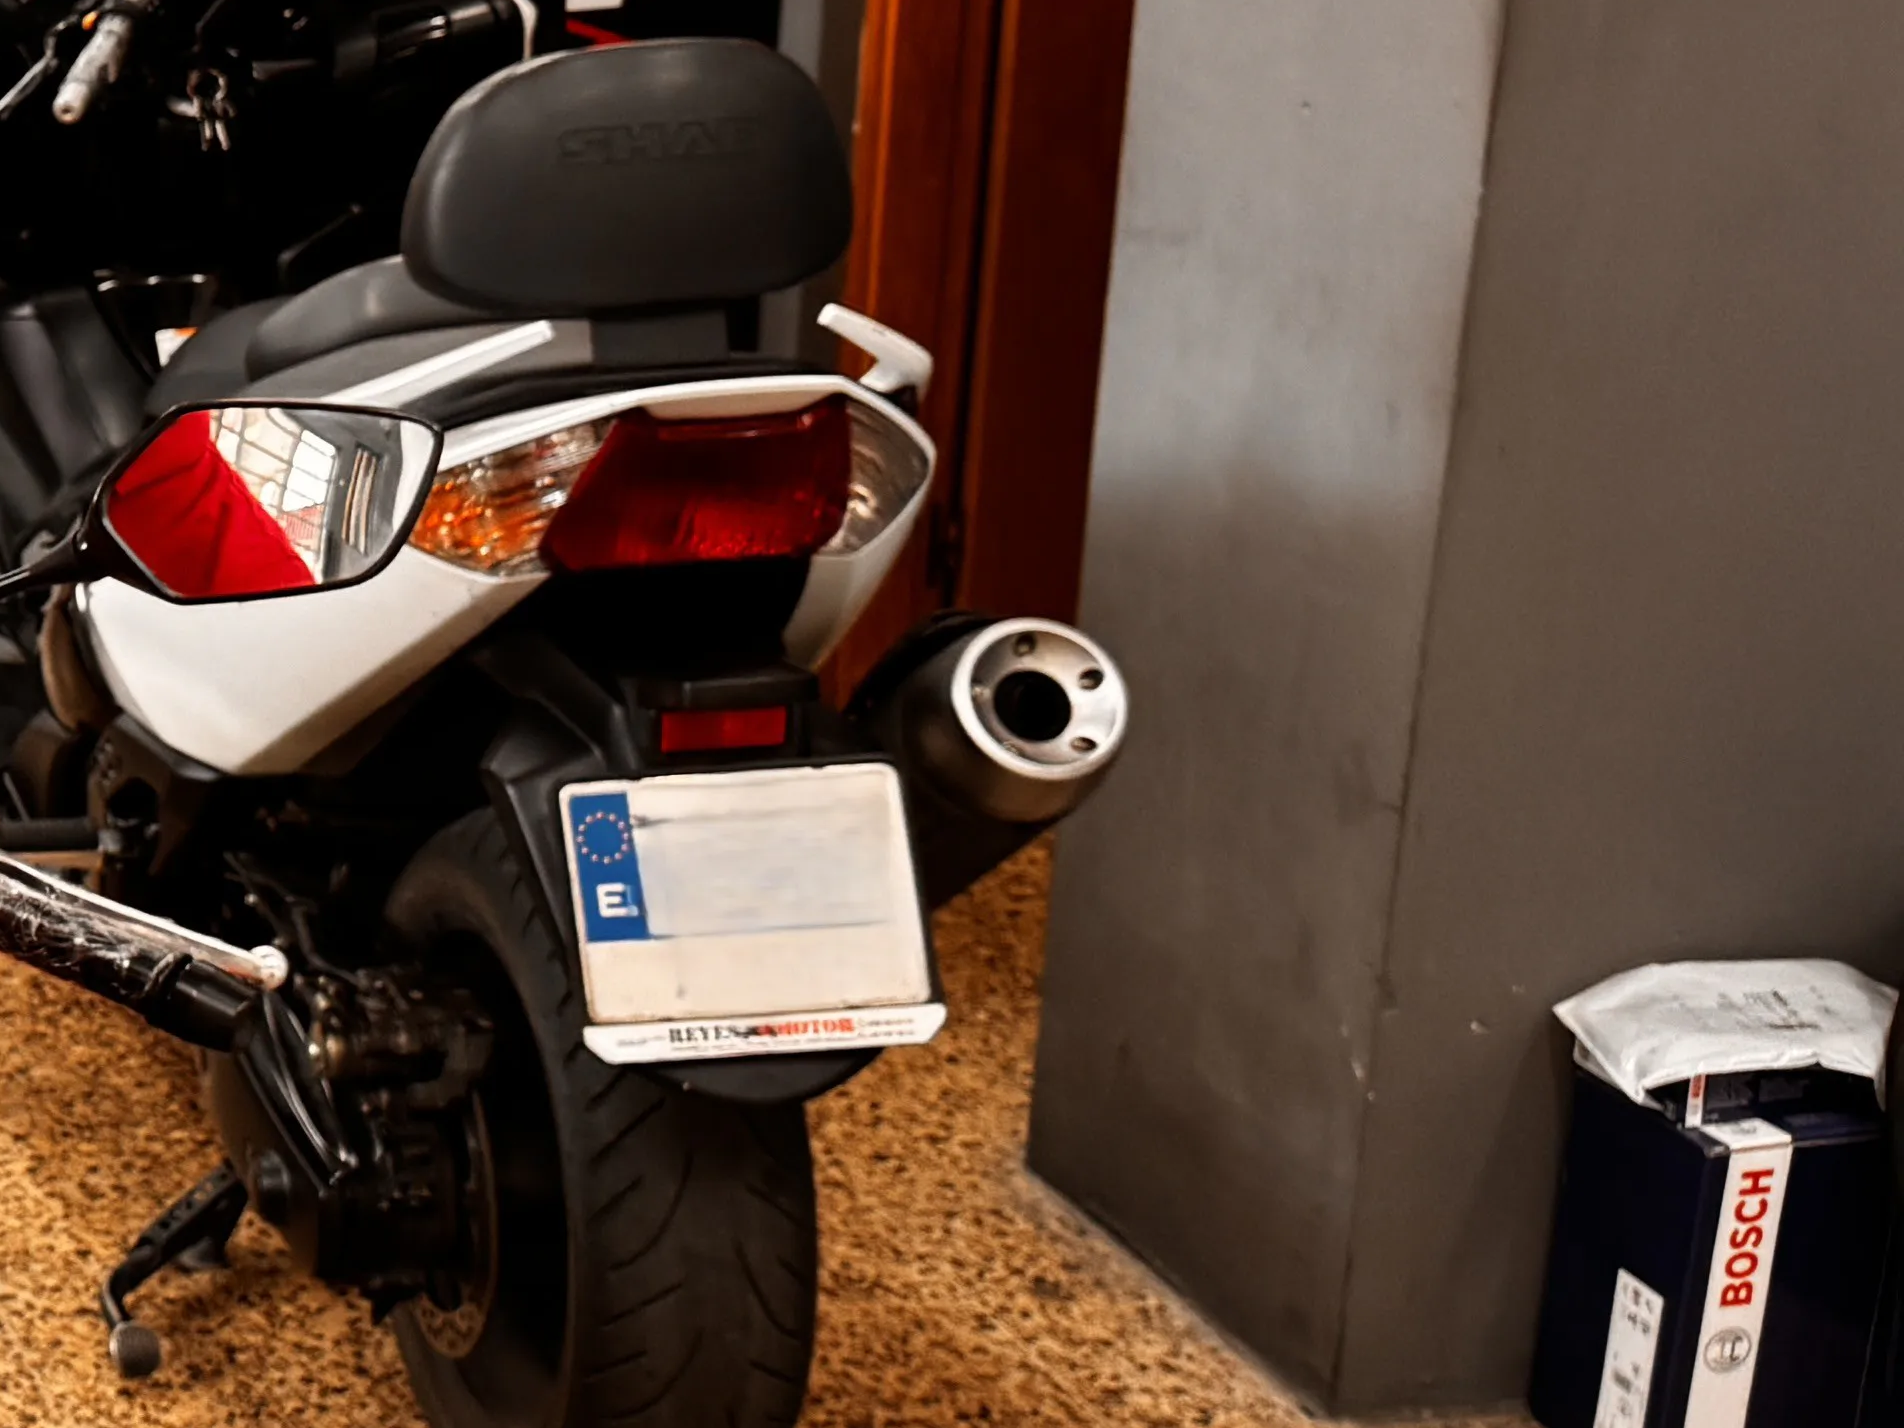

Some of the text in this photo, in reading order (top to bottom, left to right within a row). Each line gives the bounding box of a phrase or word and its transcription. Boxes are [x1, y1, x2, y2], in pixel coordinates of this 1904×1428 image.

[596, 883, 638, 918] E
[669, 1025, 741, 1044] REYES
[1719, 1168, 1775, 1308] BOSCH
